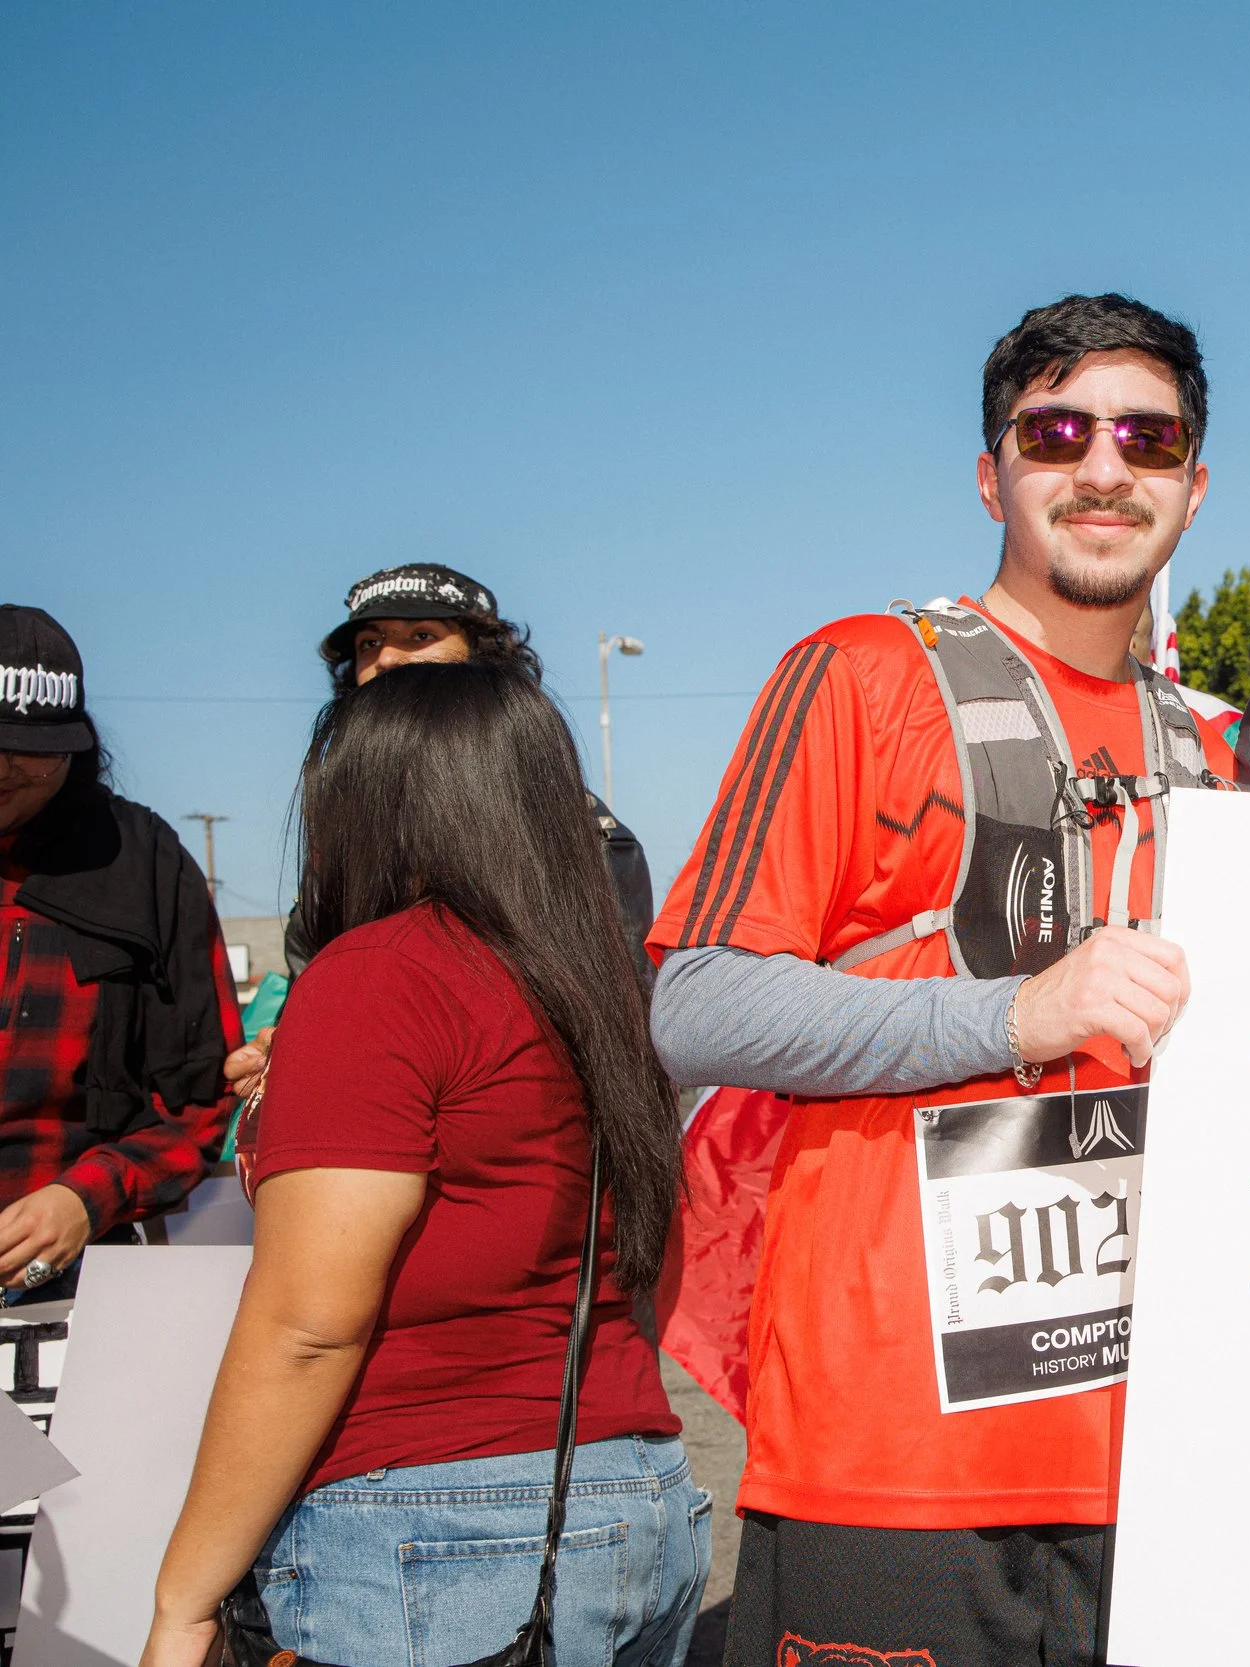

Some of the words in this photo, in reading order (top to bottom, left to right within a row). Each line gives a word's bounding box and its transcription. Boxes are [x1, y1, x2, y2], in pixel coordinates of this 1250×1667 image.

[351, 575, 427, 611] Compton
[958, 625, 989, 638] TRACKER
[1038, 857, 1056, 943] AONIJIE
[943, 1228, 959, 1281] Origins
[974, 1190, 1141, 1294] 902
[946, 1284, 964, 1325] Proud
[1031, 1316, 1132, 1352] COMPTO
[1033, 1353, 1098, 1376] HISTORY
[1102, 1341, 1131, 1366] MU
